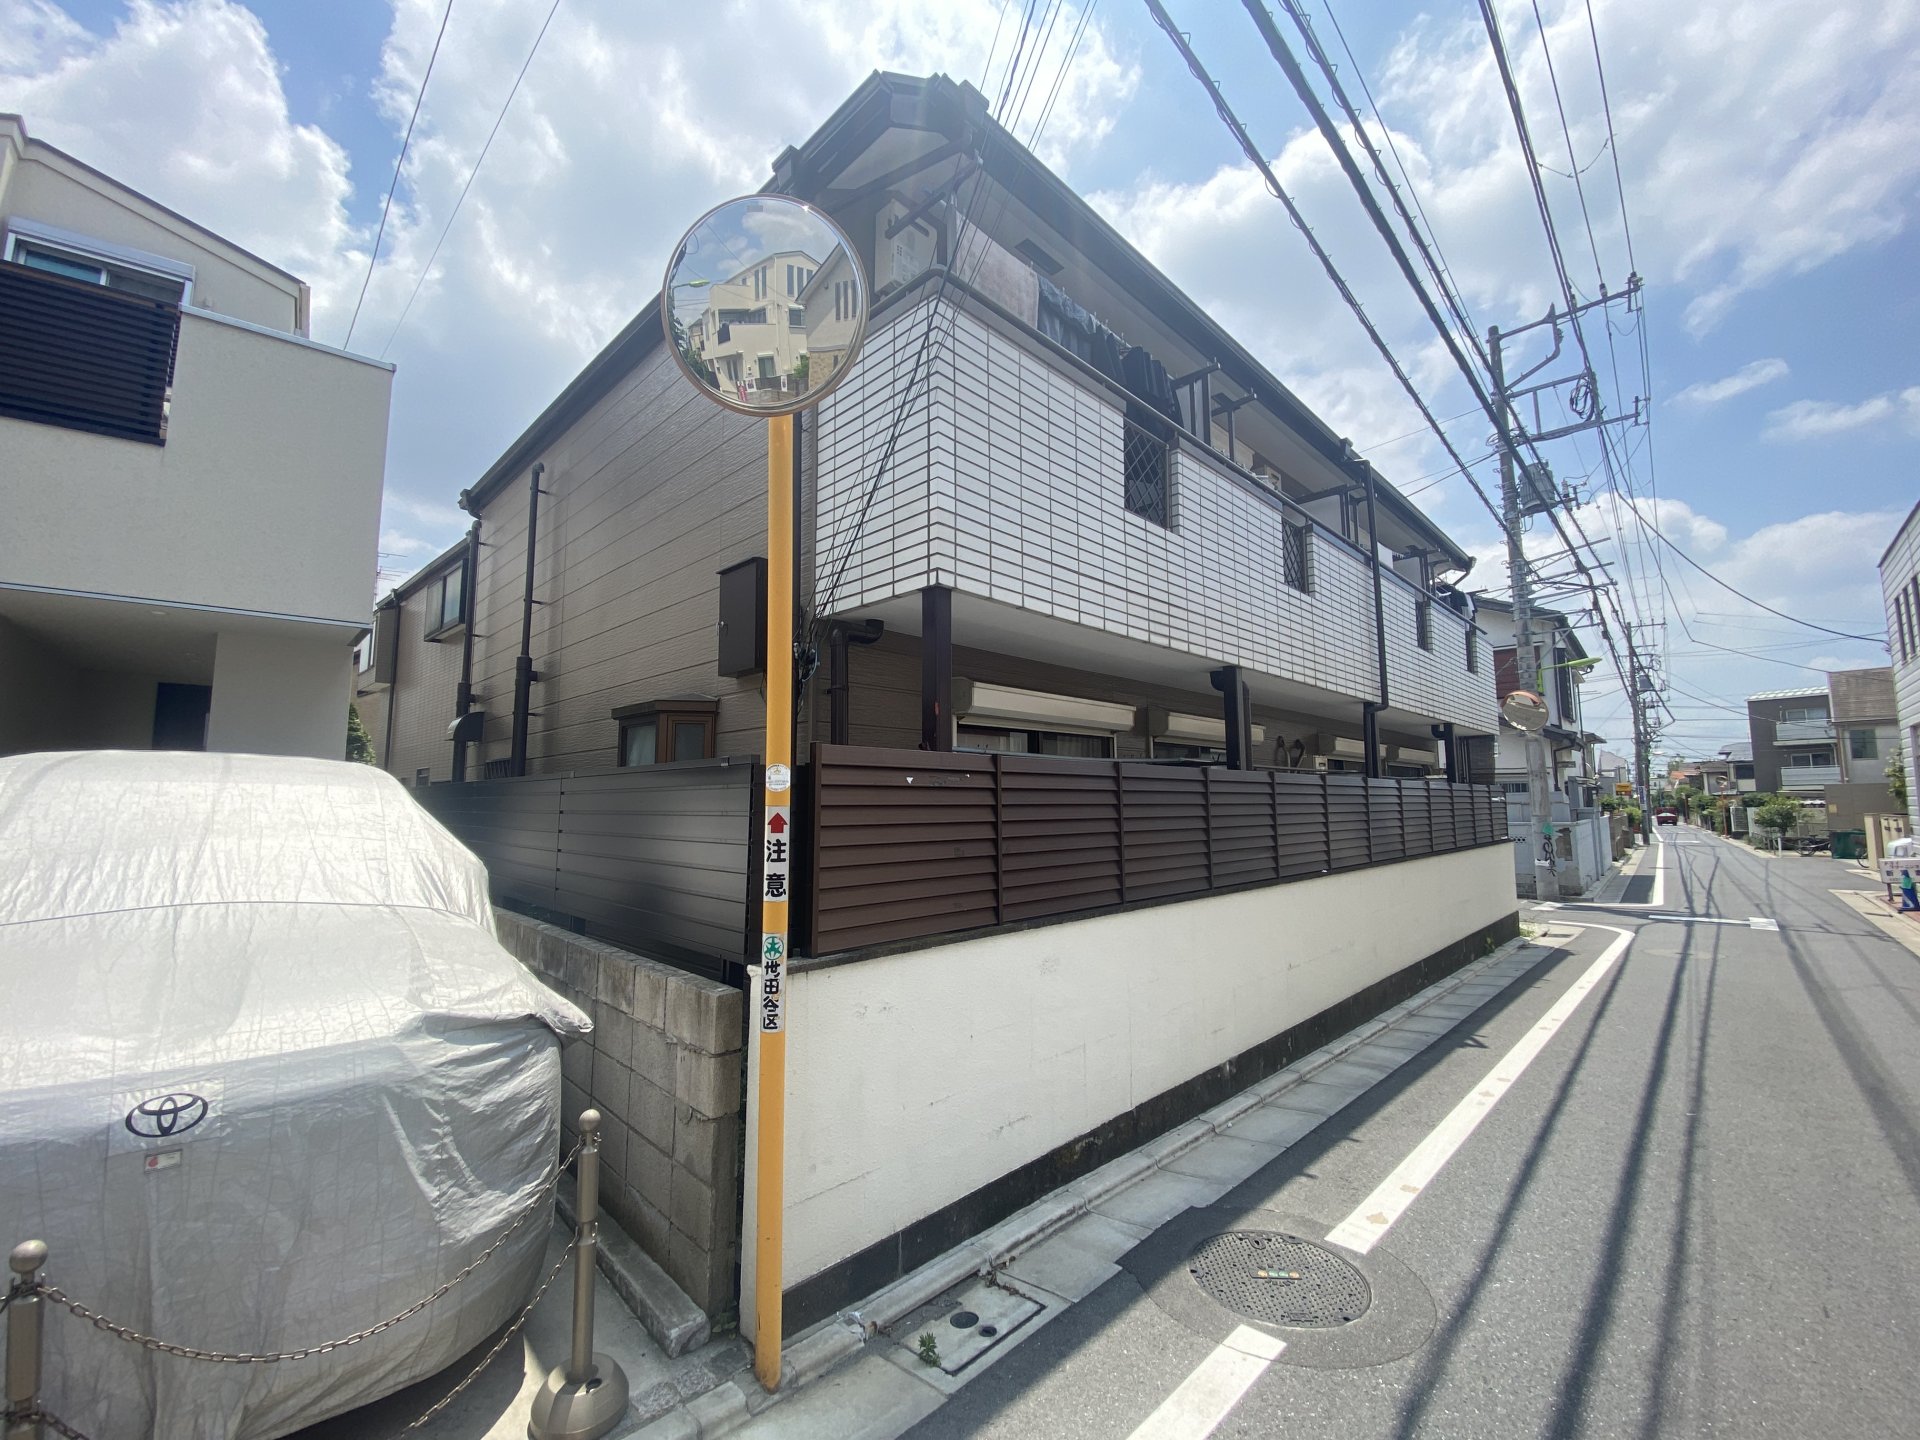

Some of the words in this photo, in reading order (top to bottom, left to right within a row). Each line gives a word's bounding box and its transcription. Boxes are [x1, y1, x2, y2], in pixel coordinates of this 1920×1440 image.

[765, 839, 787, 897] 注意
[763, 960, 781, 1029] 世田谷区
